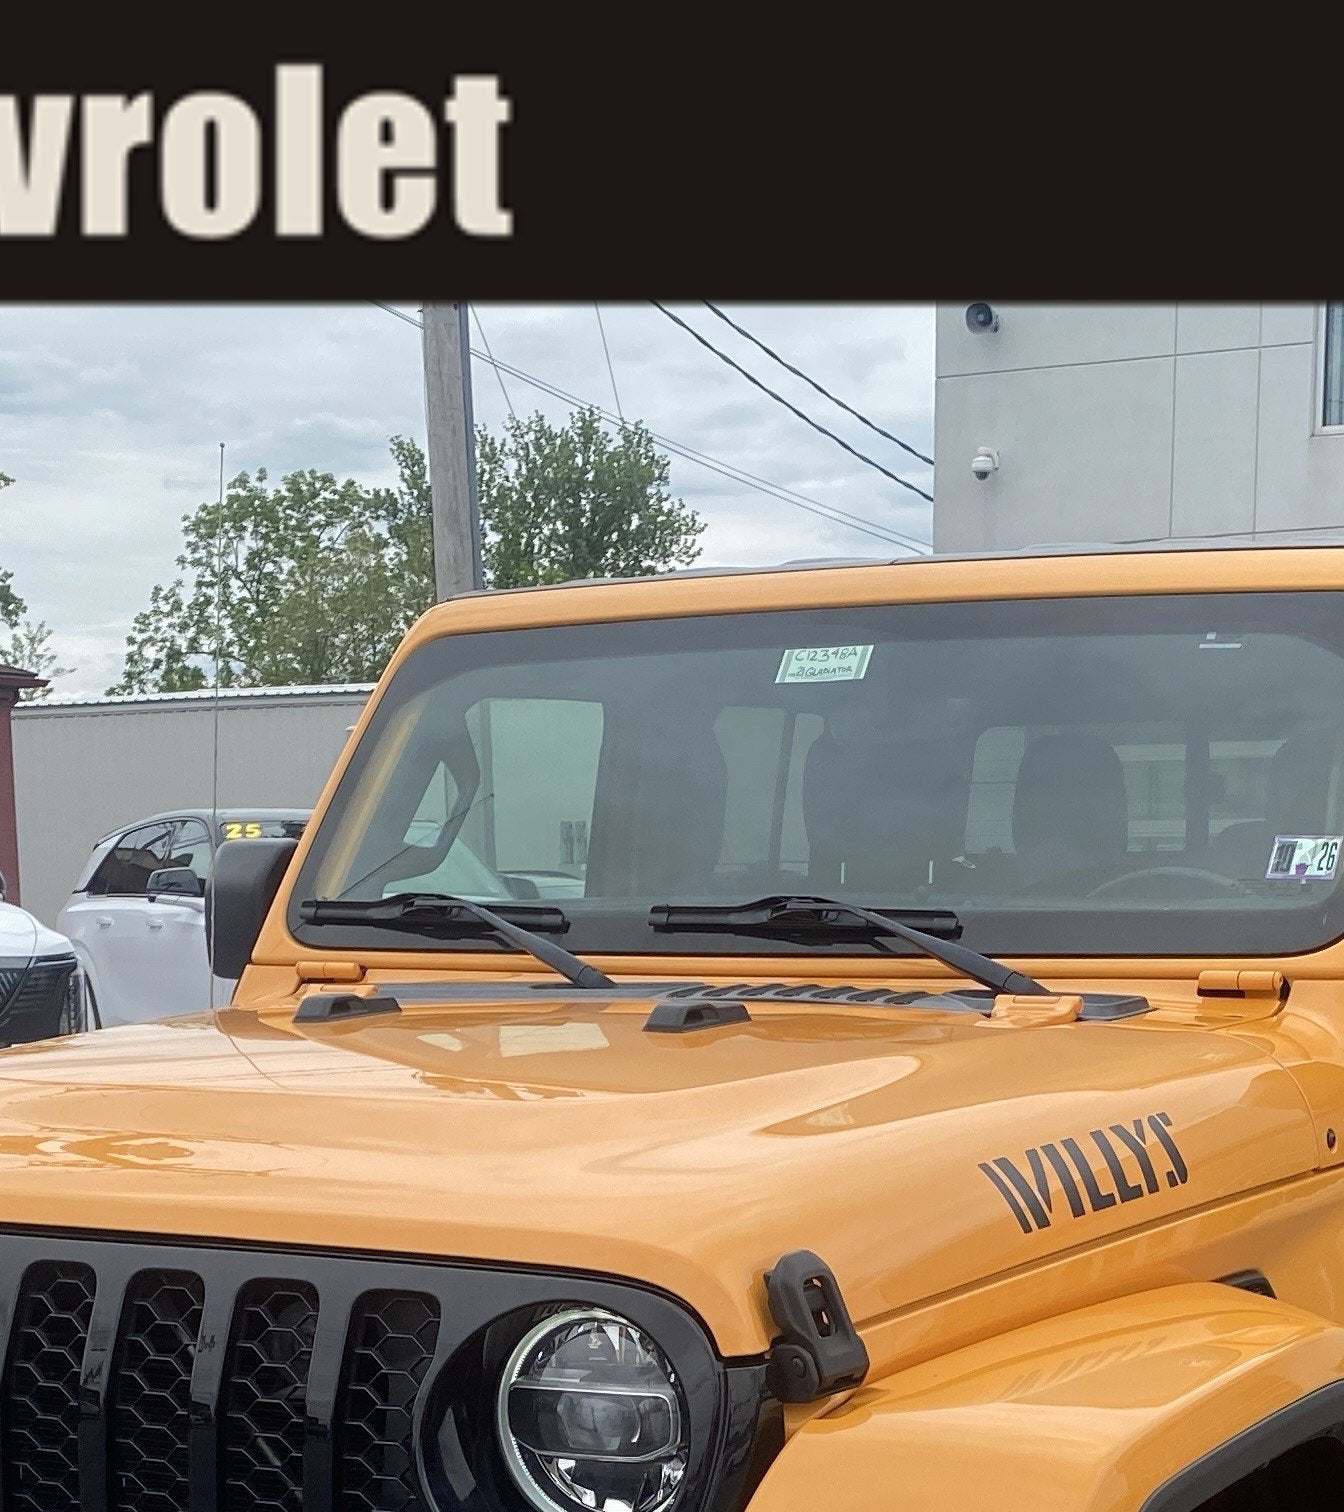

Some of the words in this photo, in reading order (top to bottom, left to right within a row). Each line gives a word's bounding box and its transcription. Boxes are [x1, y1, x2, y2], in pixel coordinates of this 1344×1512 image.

[225, 822, 262, 839] 25
[1316, 841, 1338, 872] 26
[977, 1111, 1188, 1235] WILLYS
